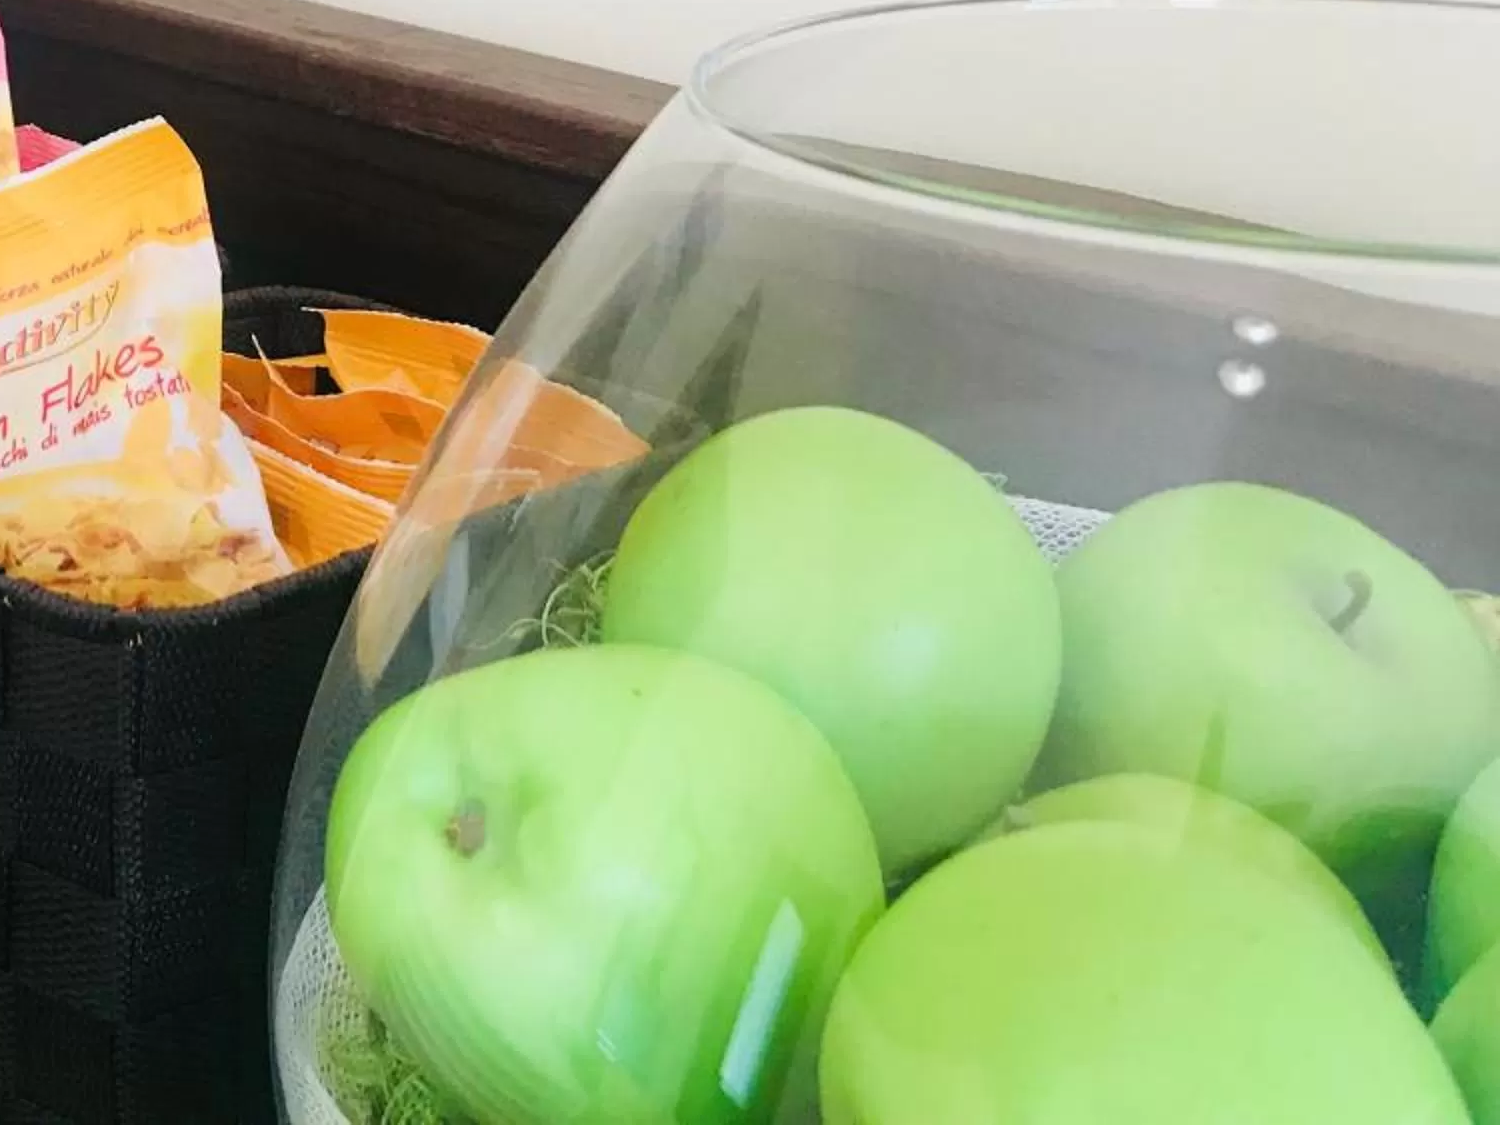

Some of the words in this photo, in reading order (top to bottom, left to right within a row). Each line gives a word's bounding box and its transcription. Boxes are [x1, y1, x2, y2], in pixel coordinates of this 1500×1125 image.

[40, 335, 165, 422] Flakes
[40, 422, 60, 452] di
[72, 402, 113, 437] mais
[123, 369, 192, 409] tostati
